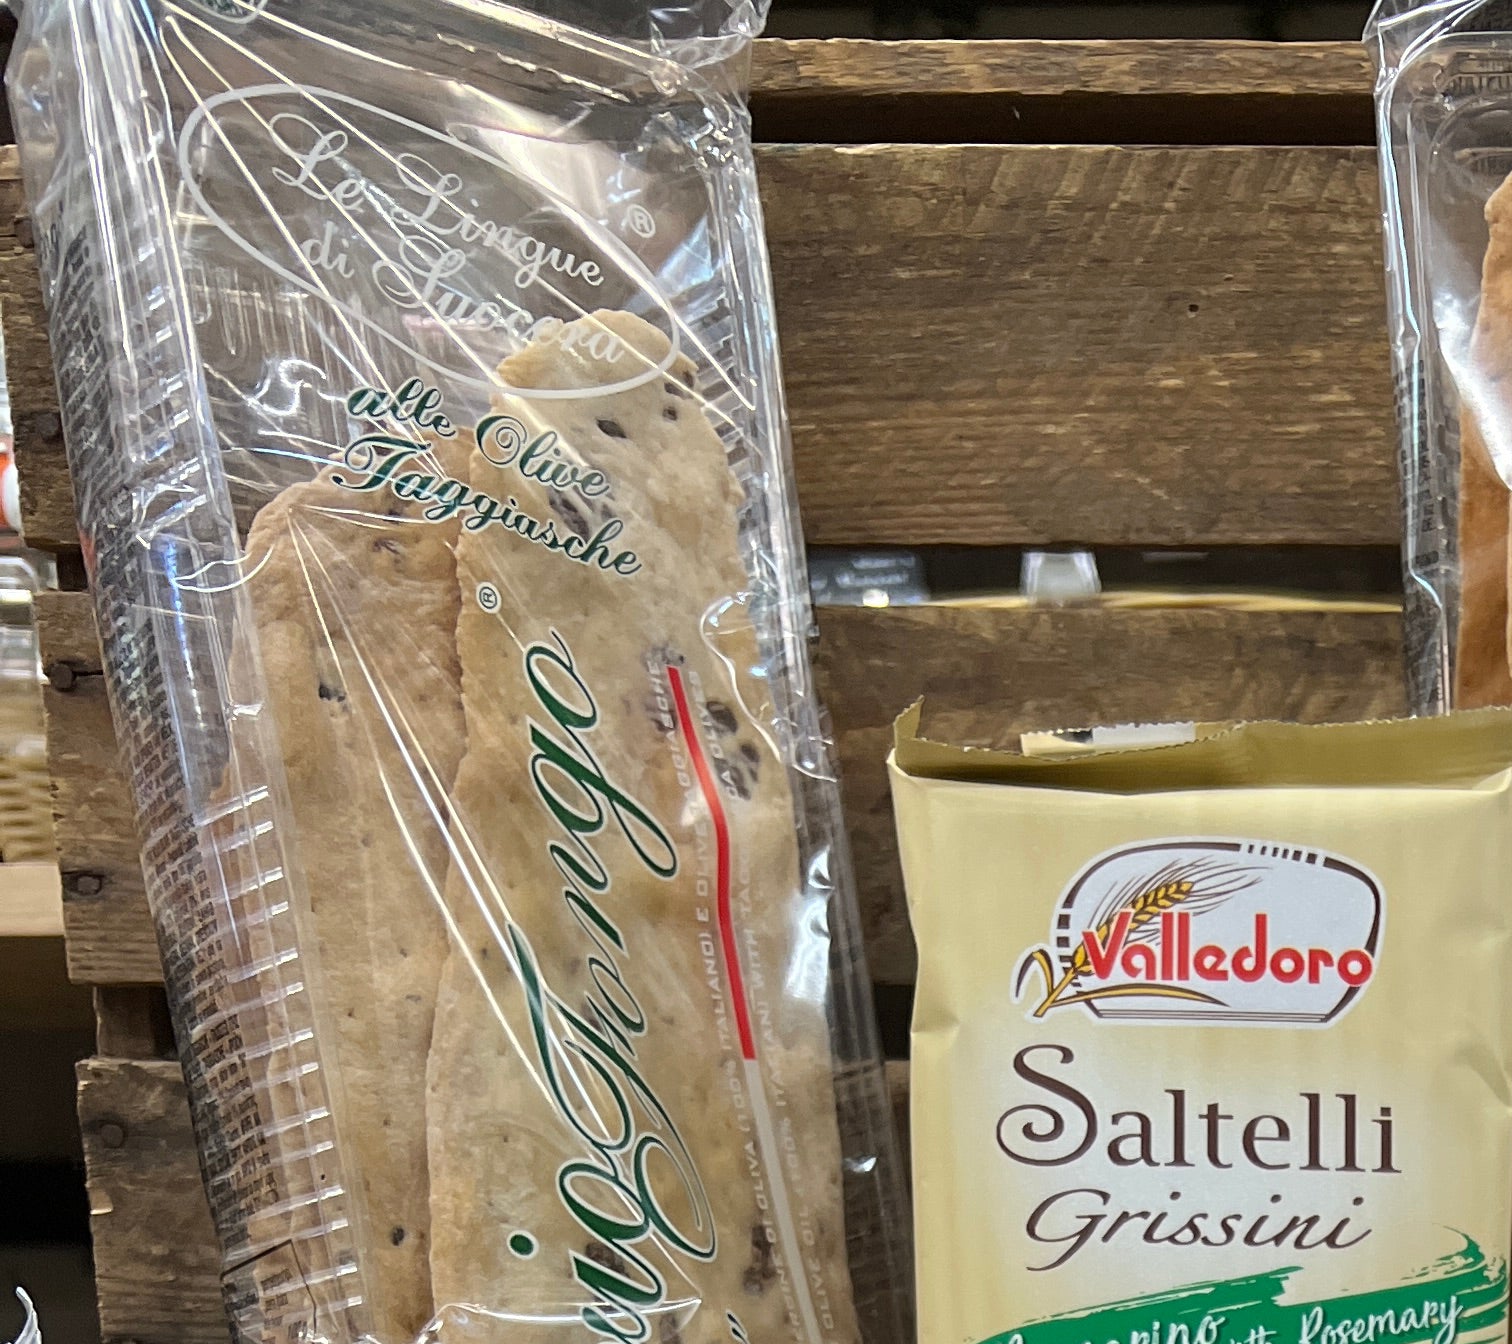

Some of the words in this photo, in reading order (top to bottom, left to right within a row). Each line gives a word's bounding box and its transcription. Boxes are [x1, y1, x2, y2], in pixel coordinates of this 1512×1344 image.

[269, 112, 368, 211] Le
[394, 151, 606, 287] Lingue
[300, 228, 356, 281] di
[347, 378, 458, 438] alle
[472, 410, 611, 499] Olive
[330, 427, 642, 577] Taggiasche
[1082, 910, 1374, 989] Valledoro
[995, 1043, 1403, 1175] Saltelli
[1024, 1187, 1374, 1272] Grissini
